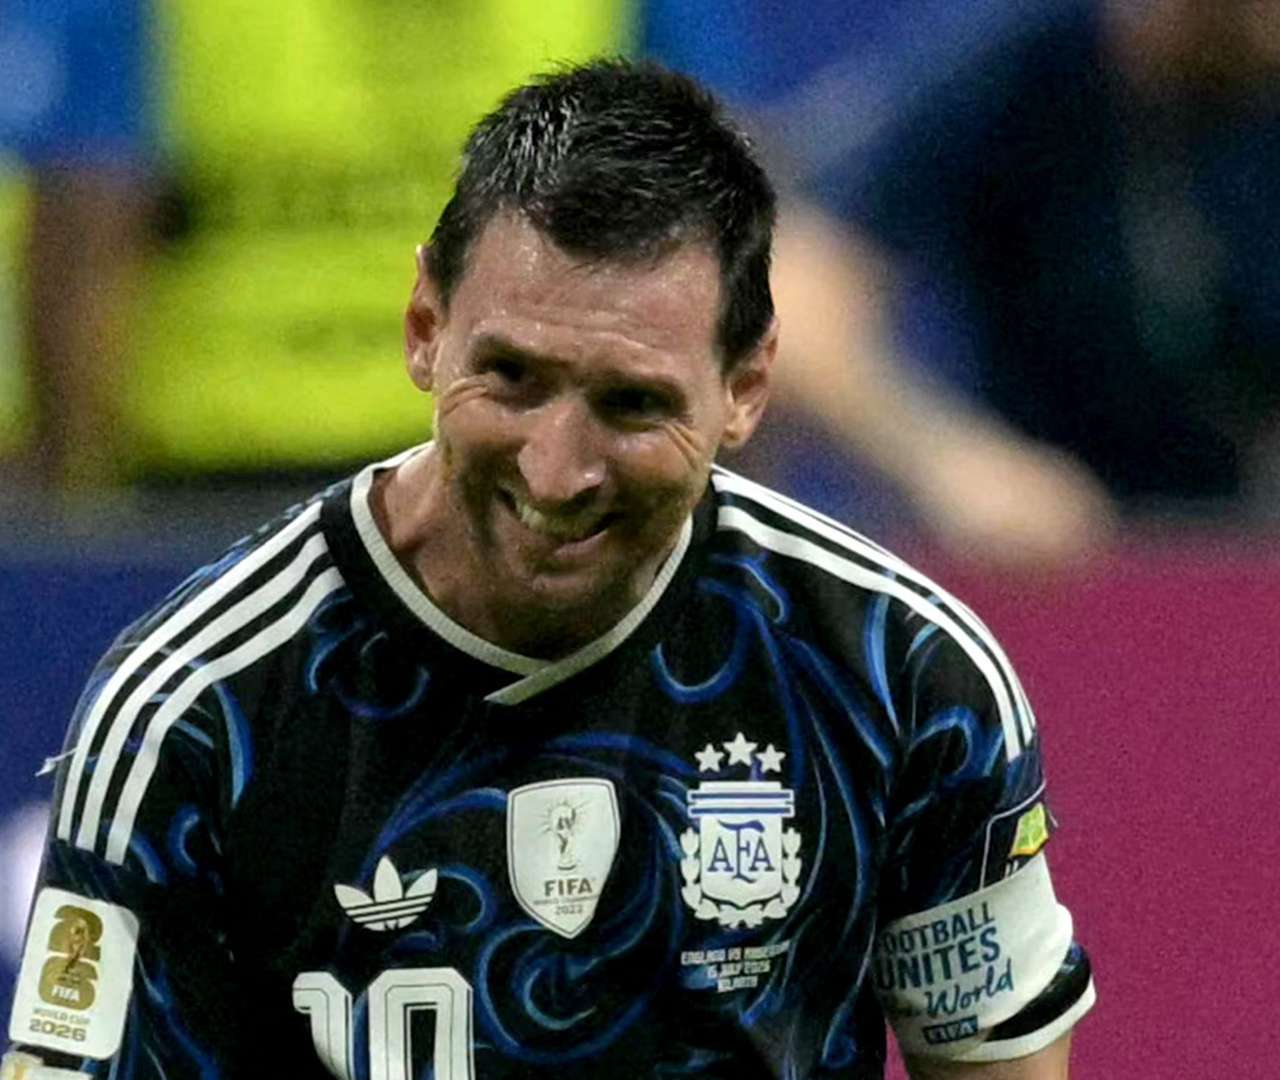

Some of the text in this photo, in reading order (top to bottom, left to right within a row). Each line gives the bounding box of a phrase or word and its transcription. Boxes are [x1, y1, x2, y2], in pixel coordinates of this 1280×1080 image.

[707, 819, 775, 884] AFA
[544, 878, 593, 897] FIFA
[877, 902, 995, 955] OOTBALL
[876, 927, 1001, 991] UNITES
[51, 985, 80, 1002] FIFA
[924, 957, 1015, 1018] World
[29, 1019, 87, 1042] 2026
